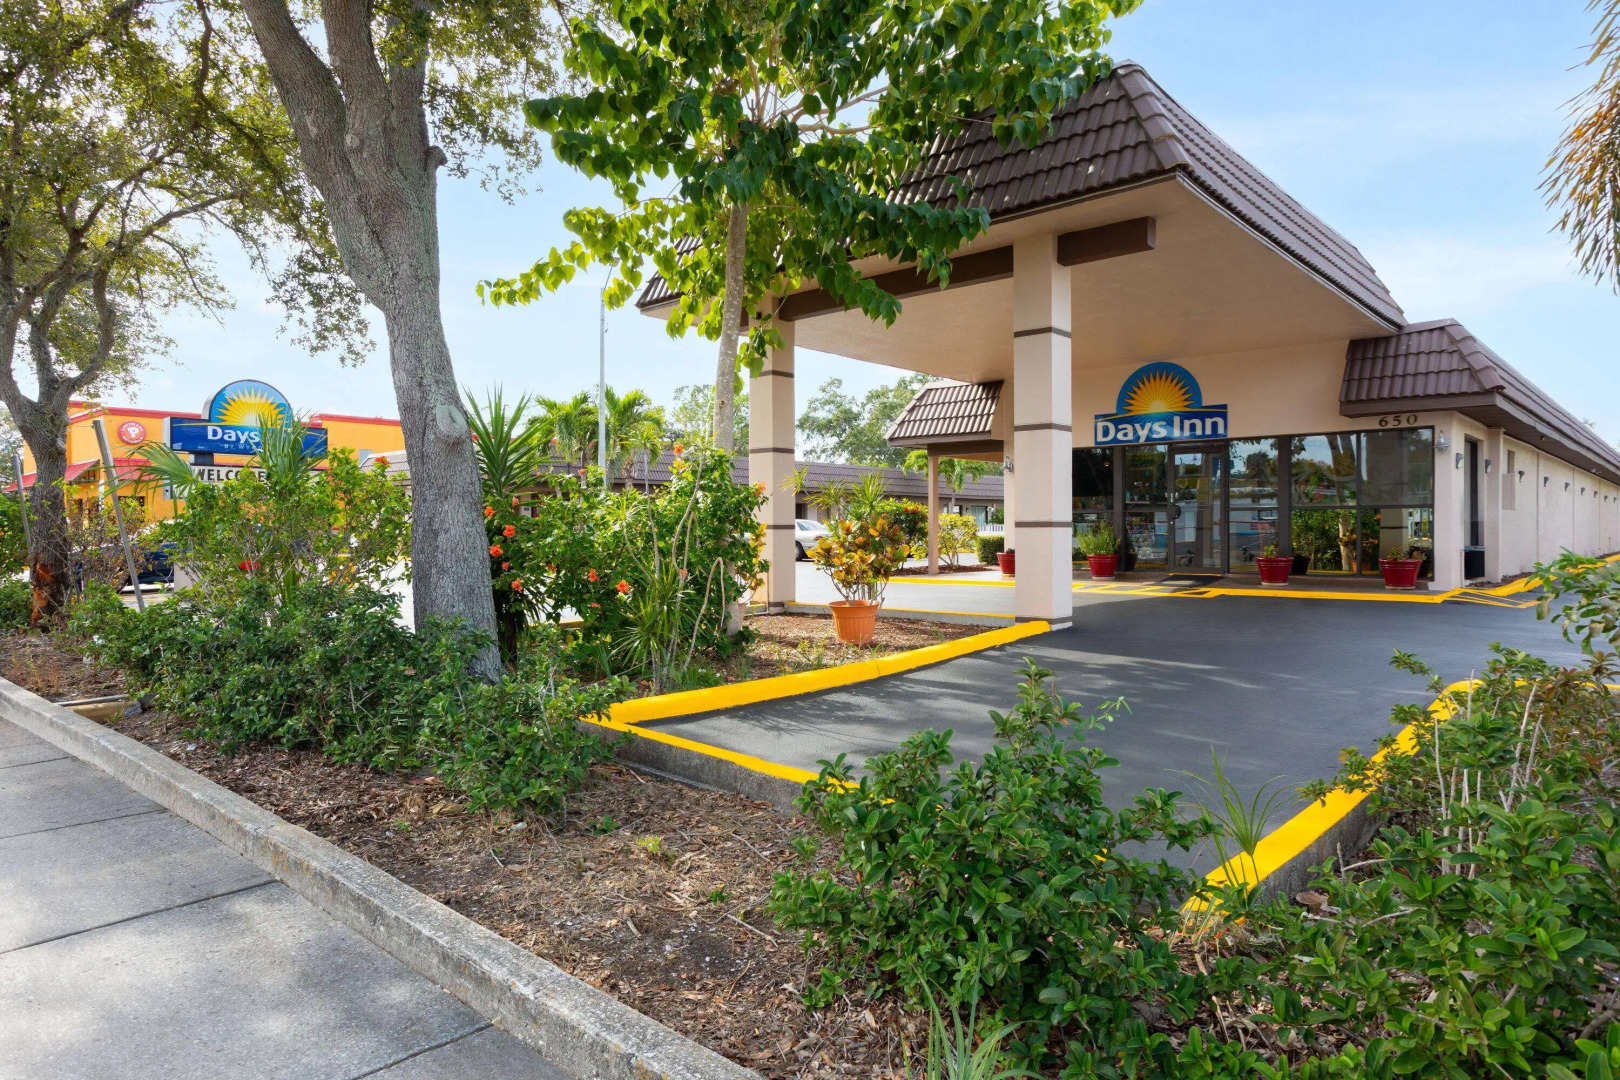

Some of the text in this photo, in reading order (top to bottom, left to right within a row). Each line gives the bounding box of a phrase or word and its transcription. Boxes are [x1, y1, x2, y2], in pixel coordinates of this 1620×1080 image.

[1378, 414, 1418, 427] 650
[207, 426, 260, 444] Days
[1096, 415, 1225, 443] Days Inn
[197, 468, 266, 483] WELCE
